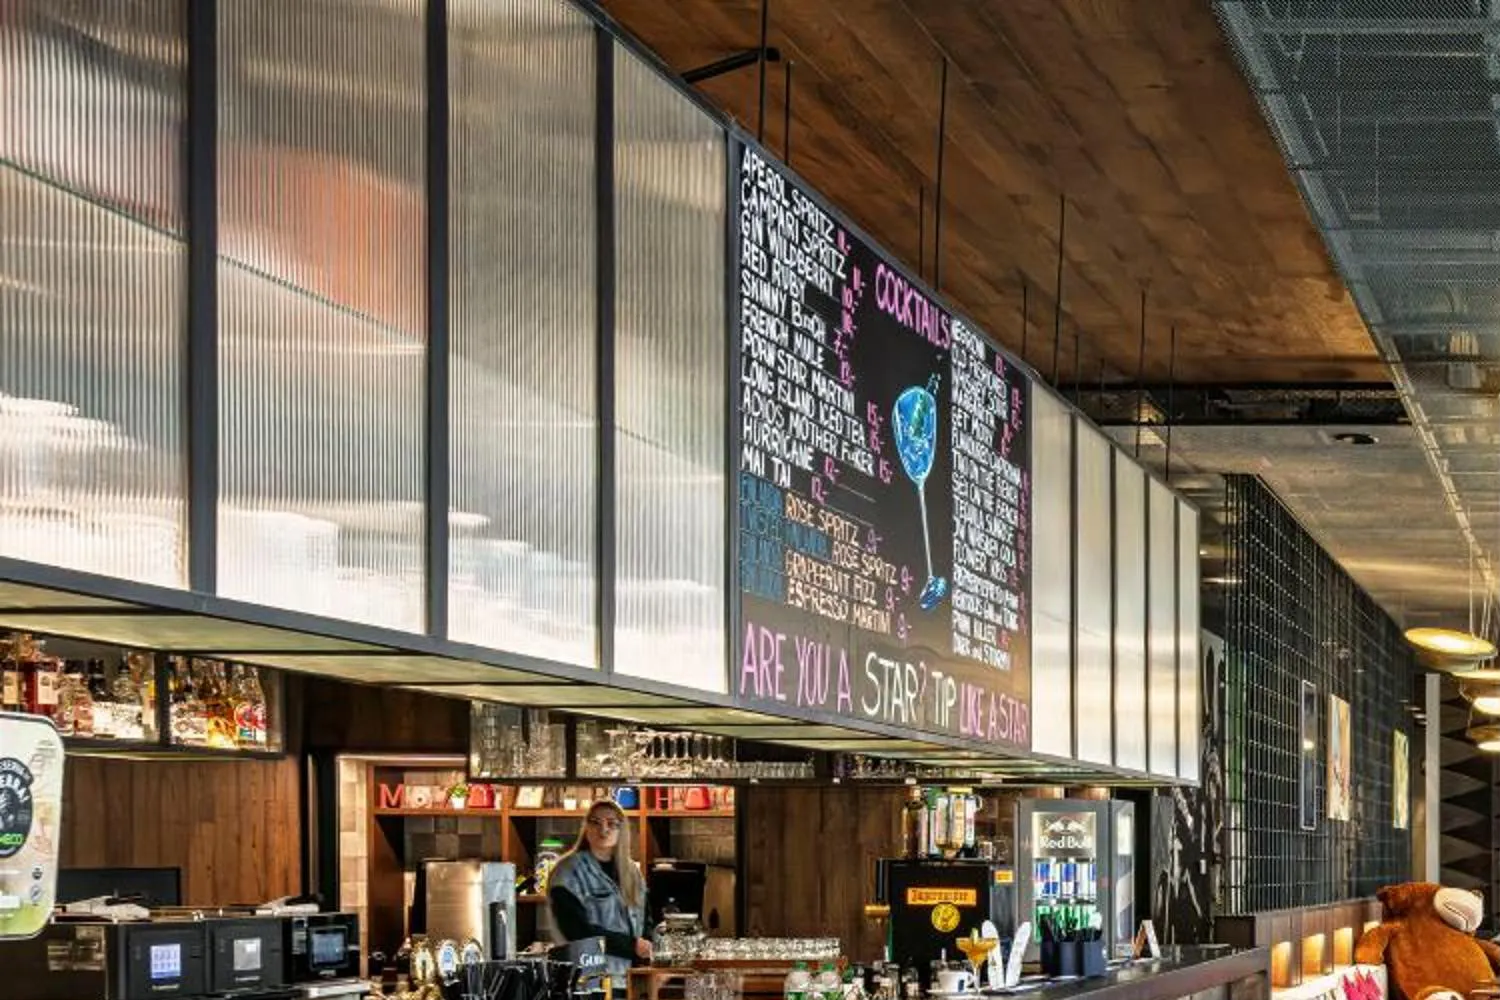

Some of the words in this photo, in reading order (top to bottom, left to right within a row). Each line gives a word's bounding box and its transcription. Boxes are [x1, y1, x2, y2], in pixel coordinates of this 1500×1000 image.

[741, 178, 798, 244] CAMPARI
[802, 225, 846, 279] SPRITZ
[742, 148, 789, 208] APEROL
[791, 189, 834, 243] SPRITZ
[741, 209, 763, 246] GIN
[767, 227, 833, 296] WILDBERRY
[741, 237, 767, 277] RED
[771, 258, 806, 303] RUBY
[741, 269, 786, 316] SKINNY
[875, 264, 950, 349] COCKTAILS
[742, 298, 788, 347] FRENCH
[793, 332, 824, 369] MULE
[741, 357, 774, 395] LONG
[777, 378, 814, 419] ISLAND
[819, 401, 842, 435] ICED
[844, 415, 865, 449] TEA
[742, 325, 774, 367] PORN
[777, 349, 806, 388] STAR
[811, 370, 854, 414] MARTINI
[742, 385, 784, 432] ADIOS
[789, 412, 837, 457] MOTHER
[743, 415, 814, 471] HURRICANE
[742, 443, 764, 477] MAI
[772, 455, 790, 488] TAI
[785, 492, 815, 527] ROSE
[818, 509, 858, 546] SPRITZ
[832, 540, 858, 569] ROSE
[861, 553, 897, 585] SPRITZ
[788, 577, 848, 620] ESPRESSO
[741, 623, 785, 700] ARE
[795, 636, 828, 706] YOU
[836, 648, 851, 713] A
[861, 651, 926, 724] STAR?
[932, 670, 956, 728] TIP
[959, 683, 984, 737] LIKE
[988, 691, 998, 739] A
[999, 692, 1028, 743] STAR
